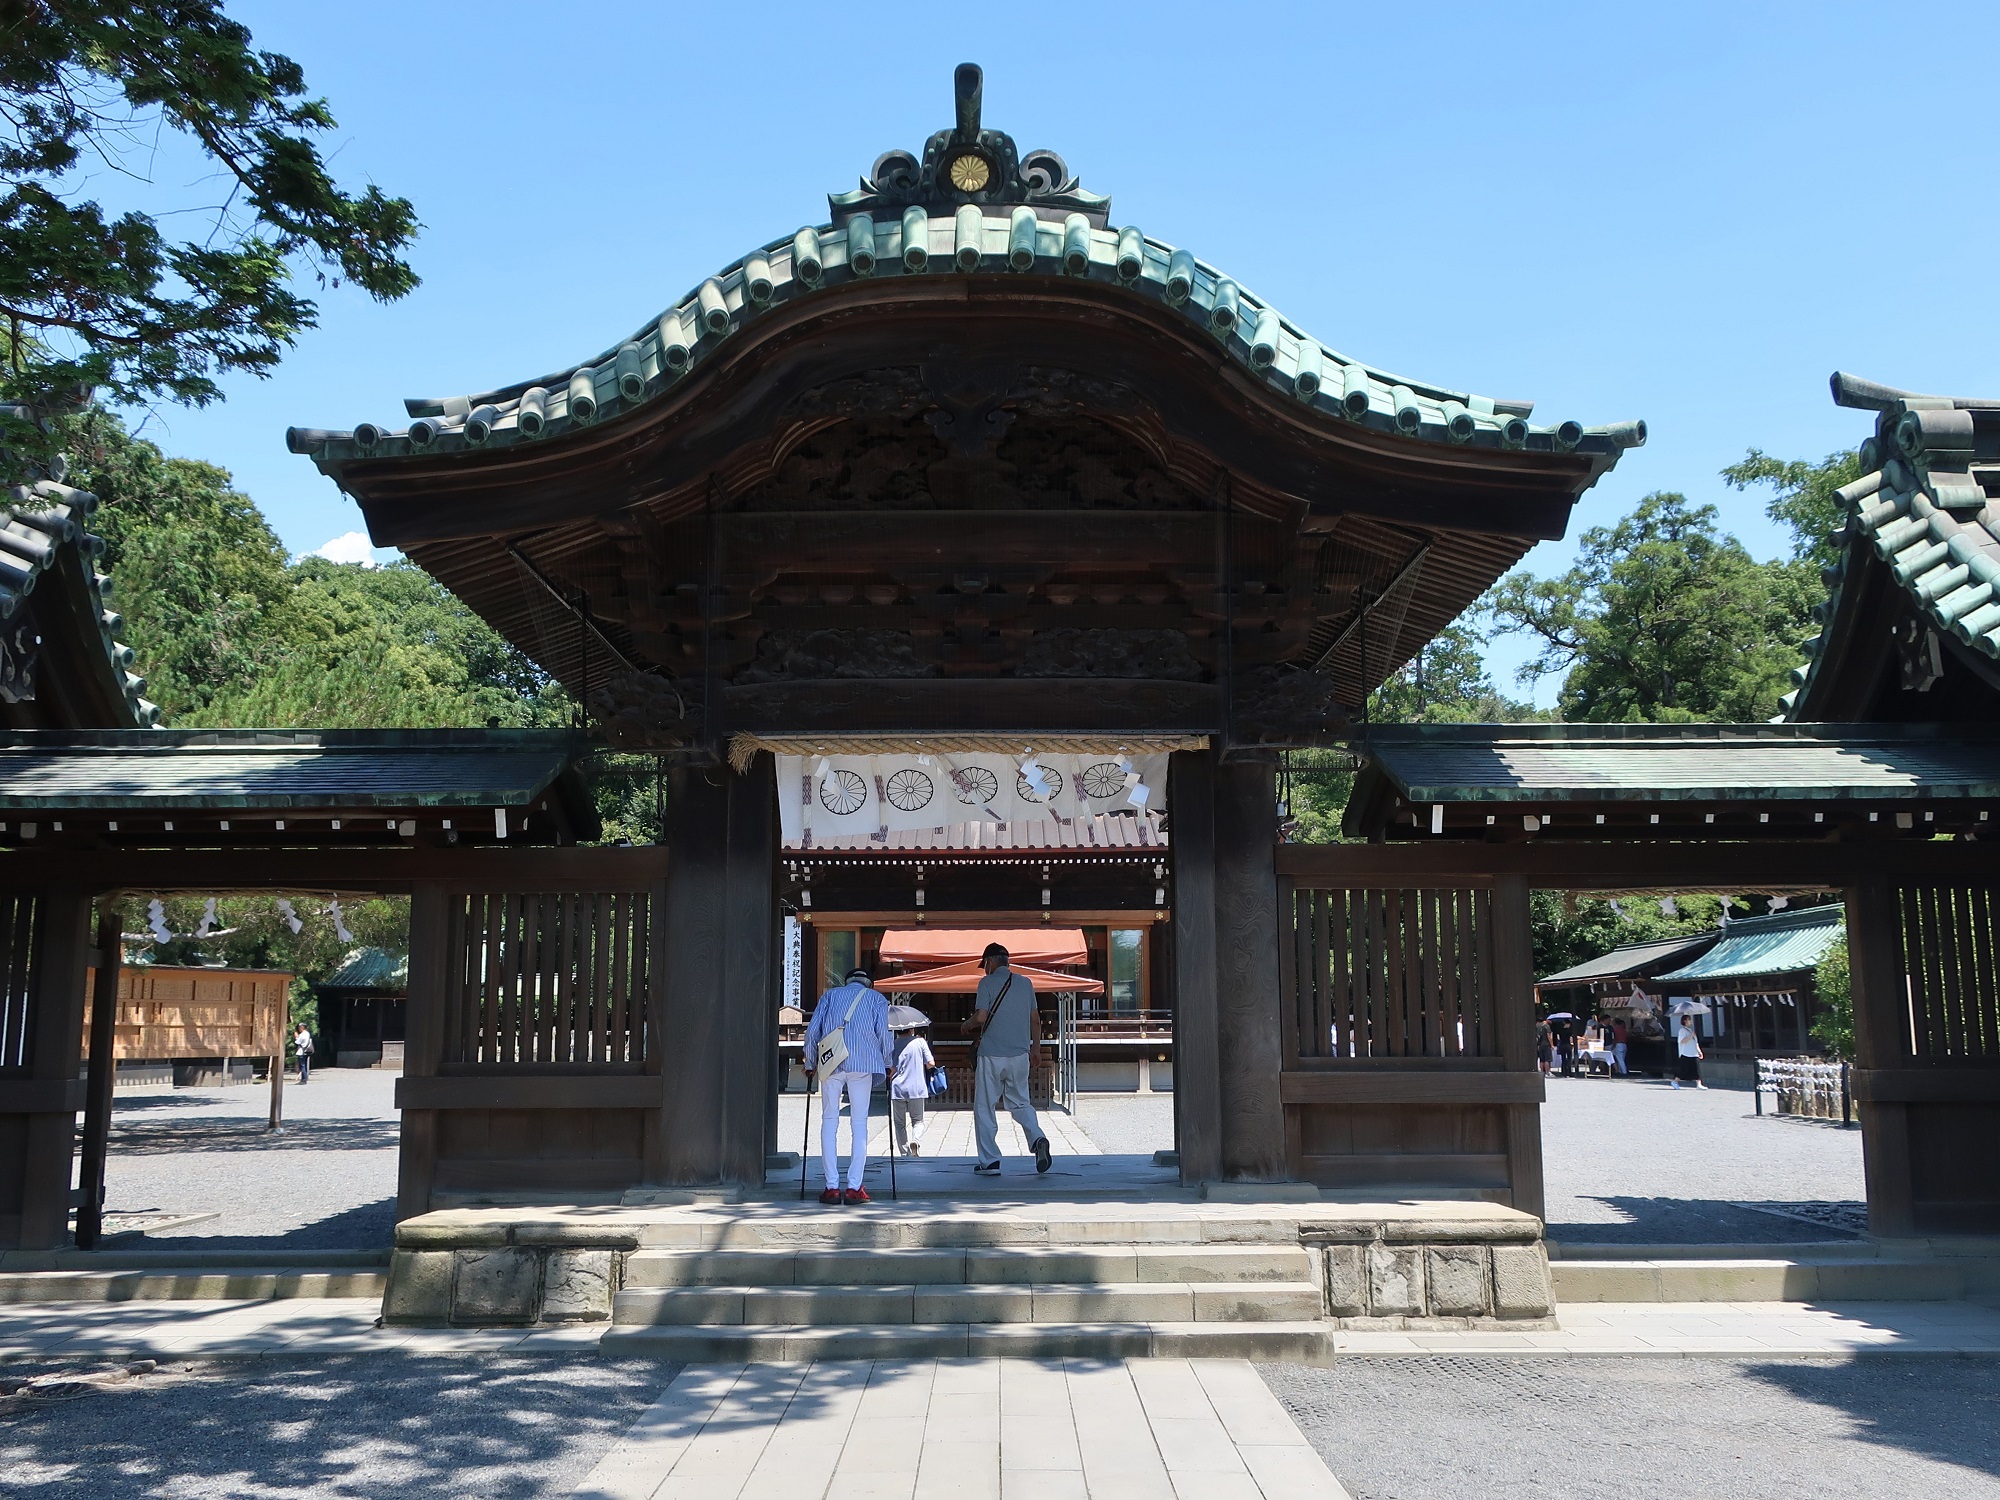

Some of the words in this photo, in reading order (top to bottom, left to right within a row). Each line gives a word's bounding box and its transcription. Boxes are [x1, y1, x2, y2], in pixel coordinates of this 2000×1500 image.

[792, 921, 801, 1007] 御大典奉祝記念事業
[821, 1050, 832, 1063] Lee
